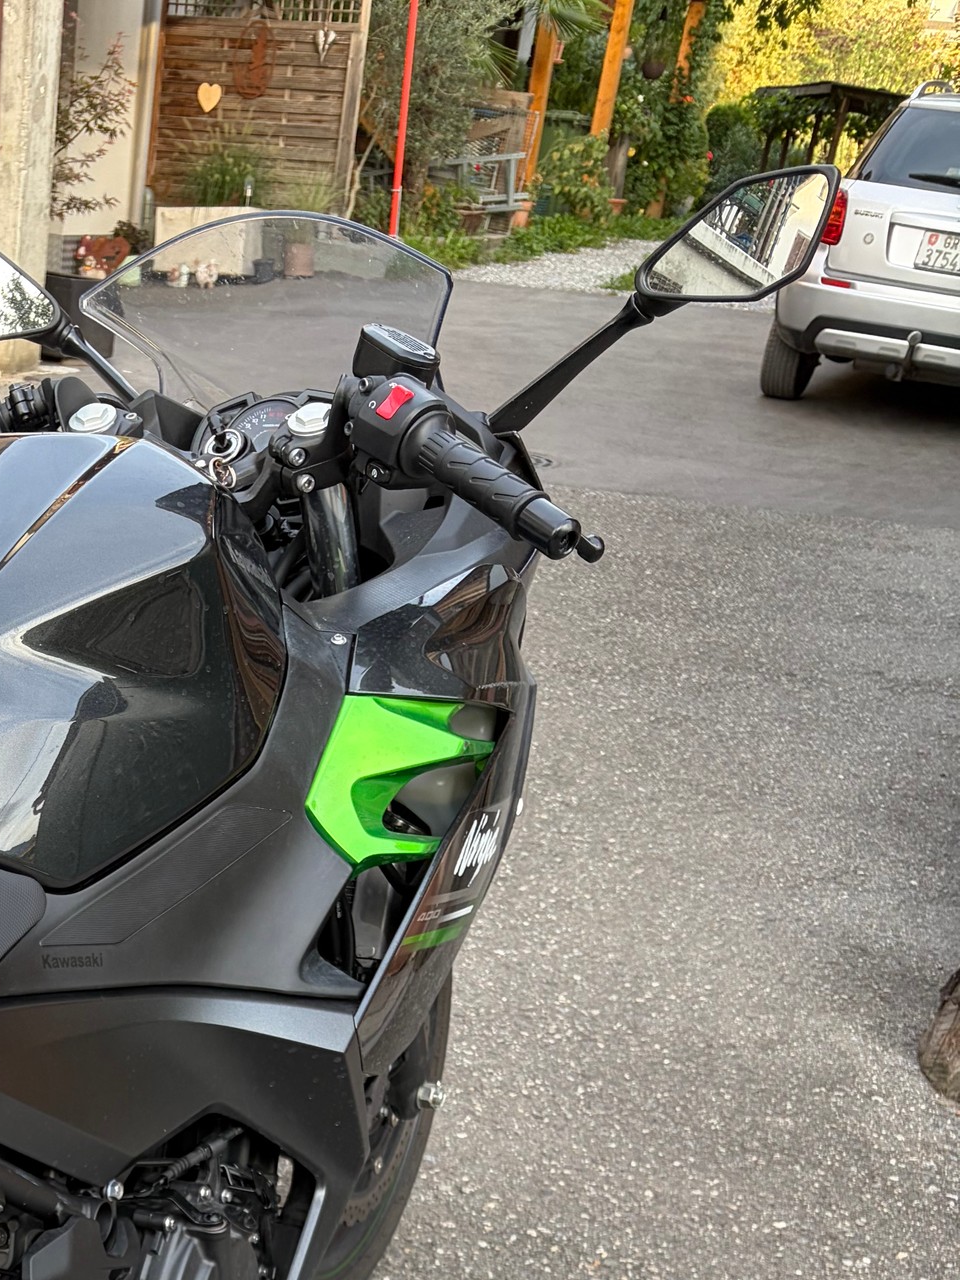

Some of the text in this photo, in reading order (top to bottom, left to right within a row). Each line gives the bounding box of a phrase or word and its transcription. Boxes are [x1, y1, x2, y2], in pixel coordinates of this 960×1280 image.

[943, 235, 960, 250] GR
[922, 248, 960, 272] 3754
[453, 808, 501, 887] Ninja
[416, 909, 441, 922] 400
[41, 952, 103, 970] Kawasaki
